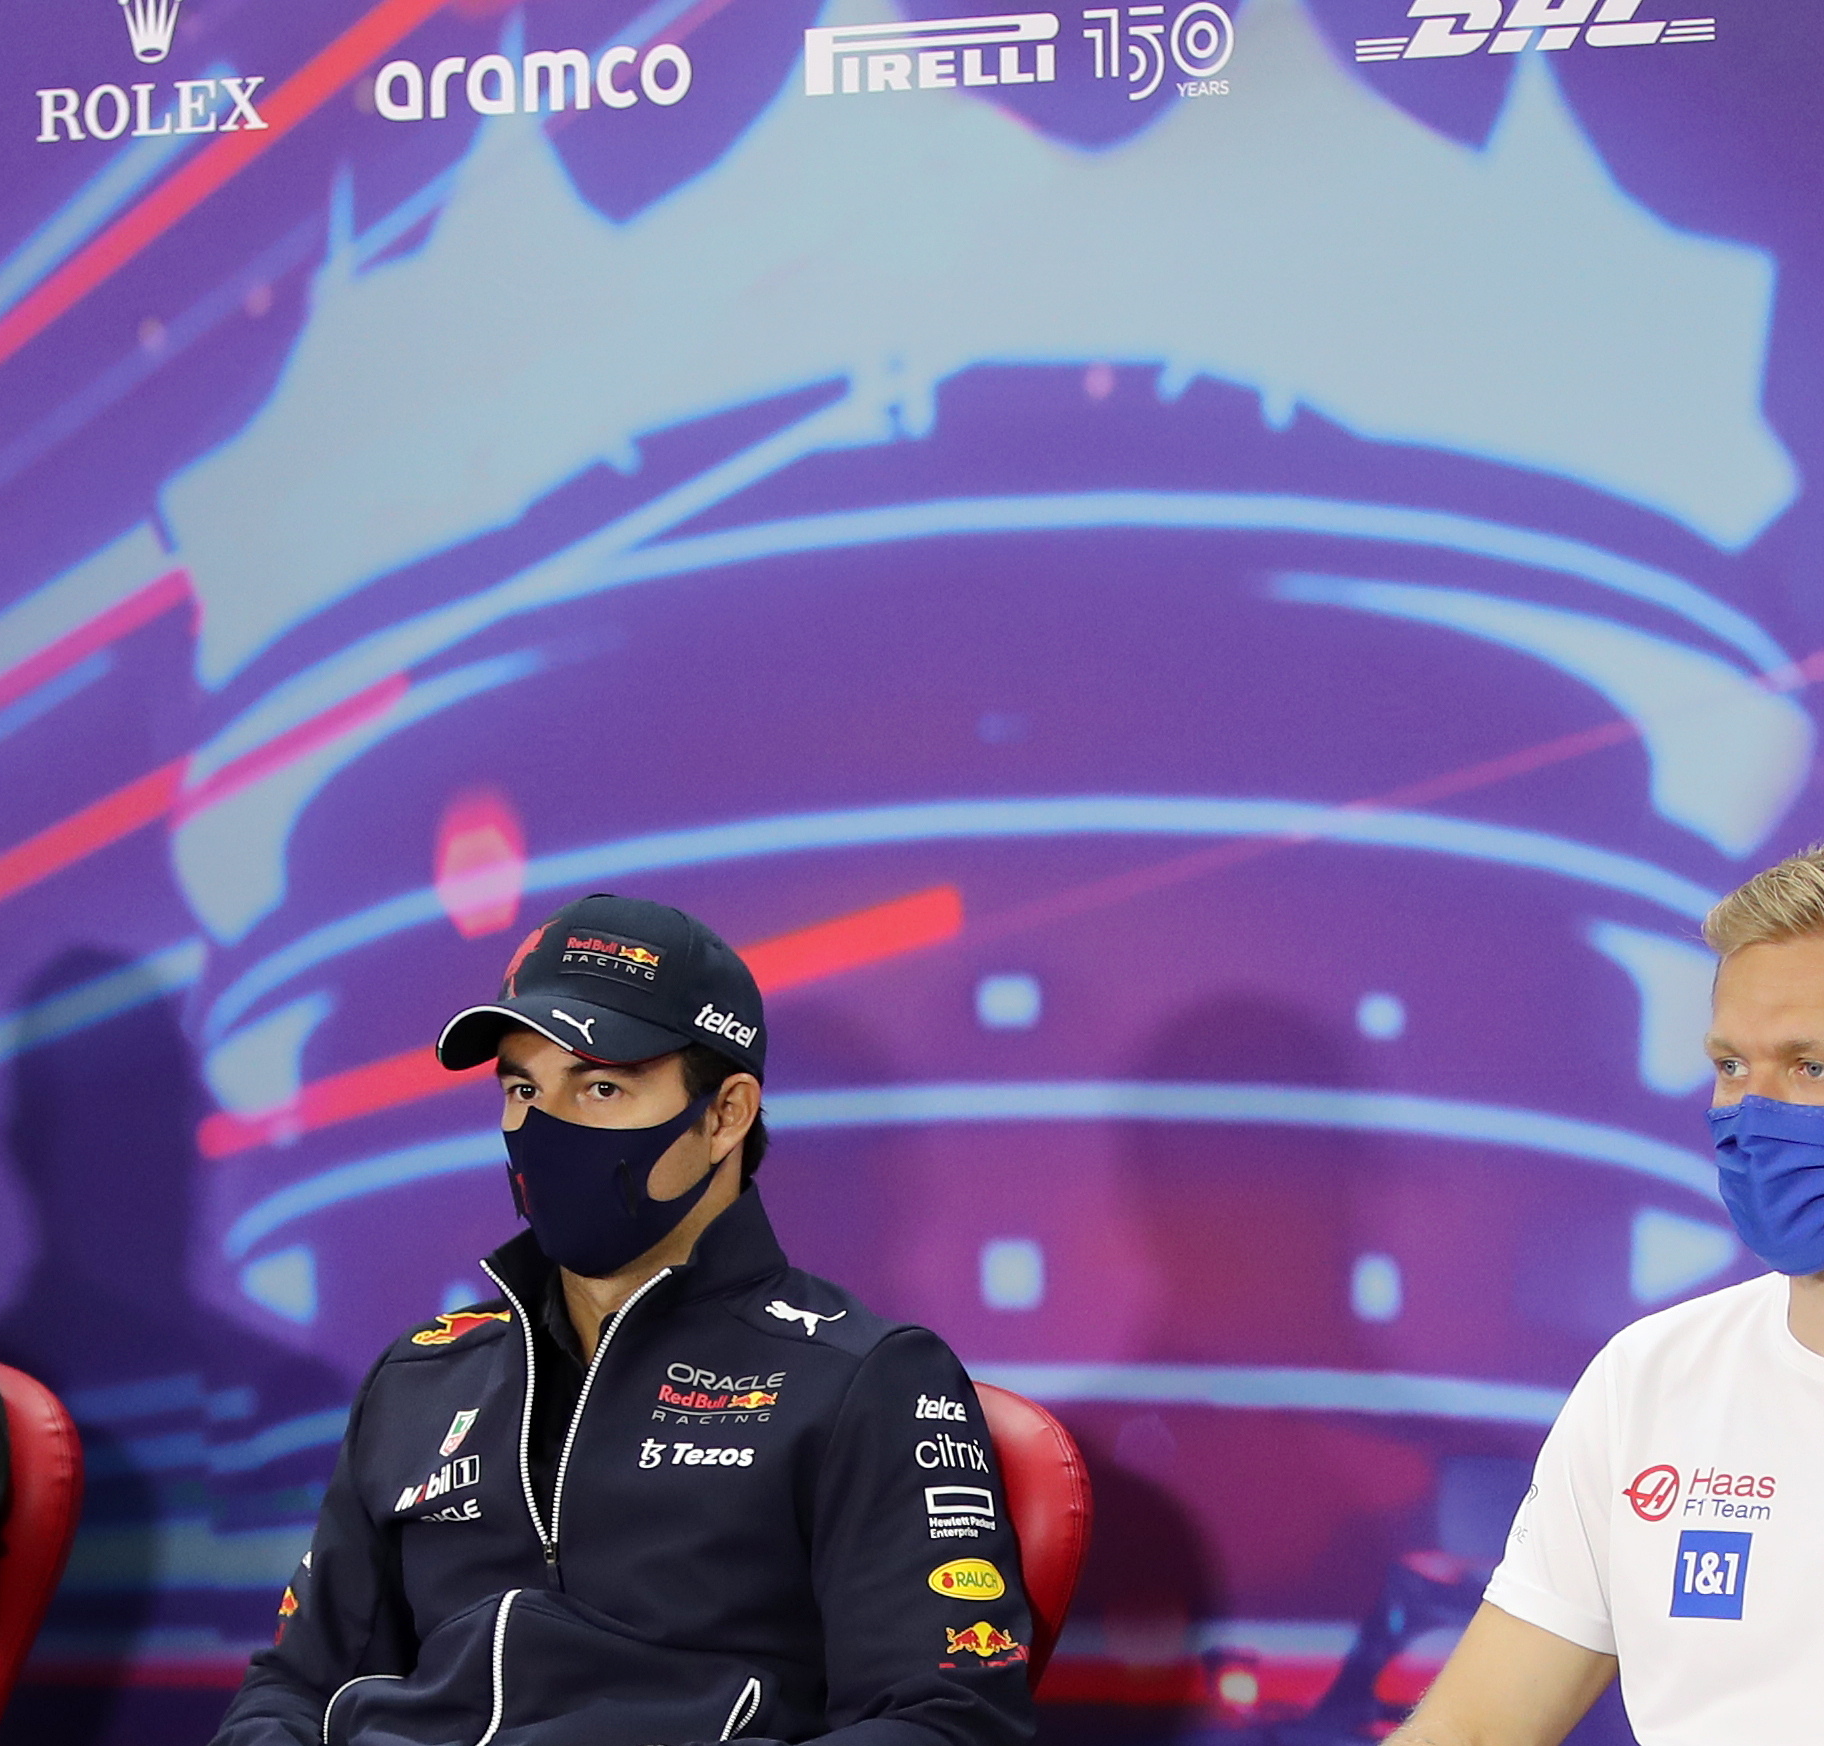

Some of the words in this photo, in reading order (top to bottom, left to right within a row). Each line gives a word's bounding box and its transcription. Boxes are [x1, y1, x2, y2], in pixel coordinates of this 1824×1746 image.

[805, 12, 1060, 96] PIRELLI
[1083, 1, 1234, 100] 150
[375, 43, 693, 121] aramco
[1176, 79, 1230, 98] YEARS
[35, 76, 269, 142] ROLEX
[562, 952, 656, 981] RACING
[694, 1003, 758, 1048] telcel
[667, 1362, 787, 1392] ORACLE
[651, 1409, 772, 1425] RACING
[671, 1442, 756, 1467] Tezos
[915, 1433, 990, 1474] citrix
[1689, 1467, 1776, 1499] Haas
[929, 1516, 971, 1527] Hewlett
[1683, 1498, 1705, 1517] F1
[1711, 1498, 1772, 1521] Team
[930, 1528, 978, 1539] Enterprise
[956, 1571, 999, 1590] RAUCH
[1682, 1551, 1741, 1596] 1&1
